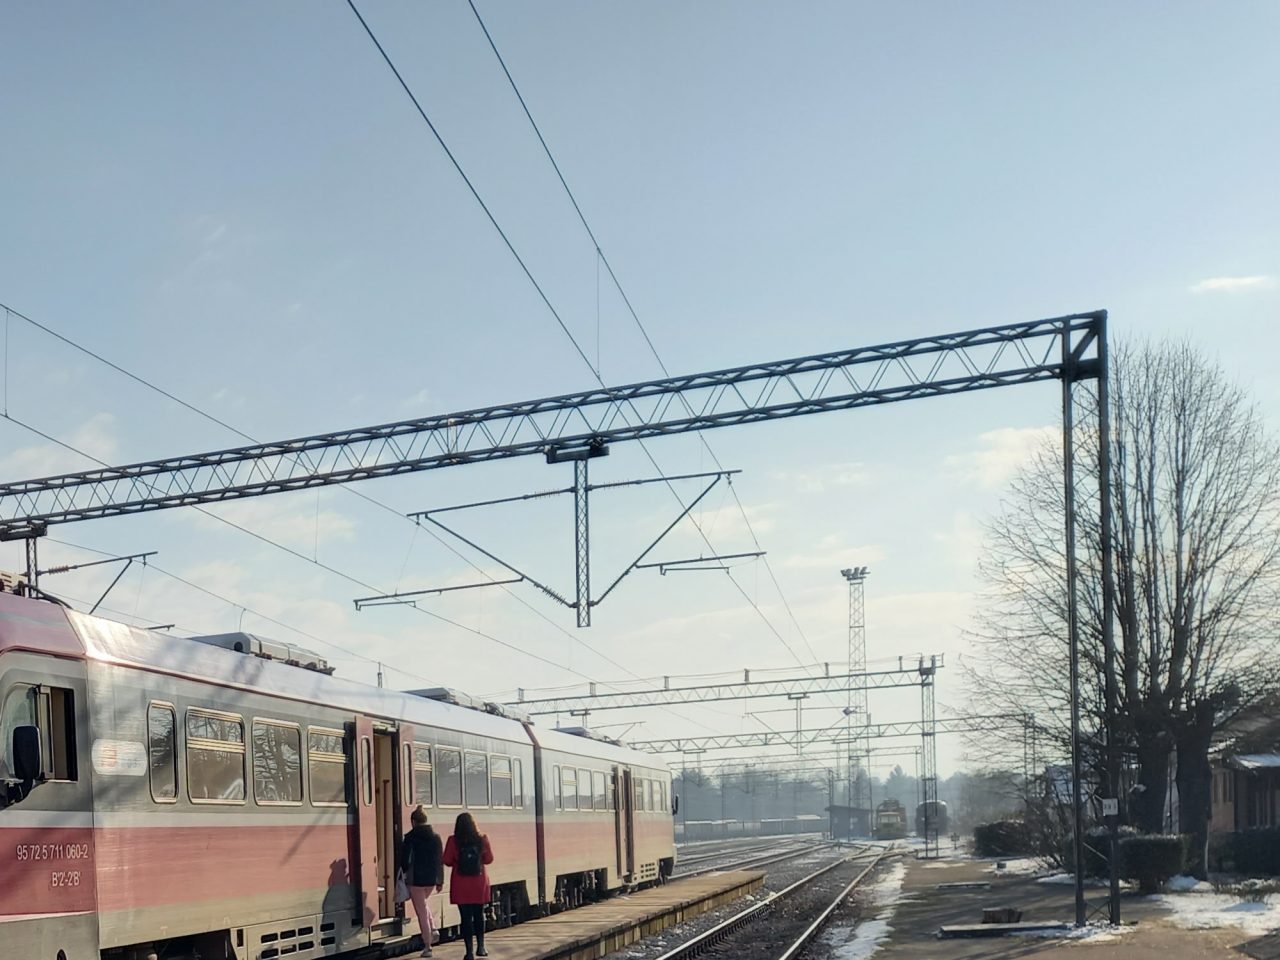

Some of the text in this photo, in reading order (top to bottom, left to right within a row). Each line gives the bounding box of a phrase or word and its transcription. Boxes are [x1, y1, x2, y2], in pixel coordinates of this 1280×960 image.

[16, 843, 88, 860] 95 72 5 711 060-2
